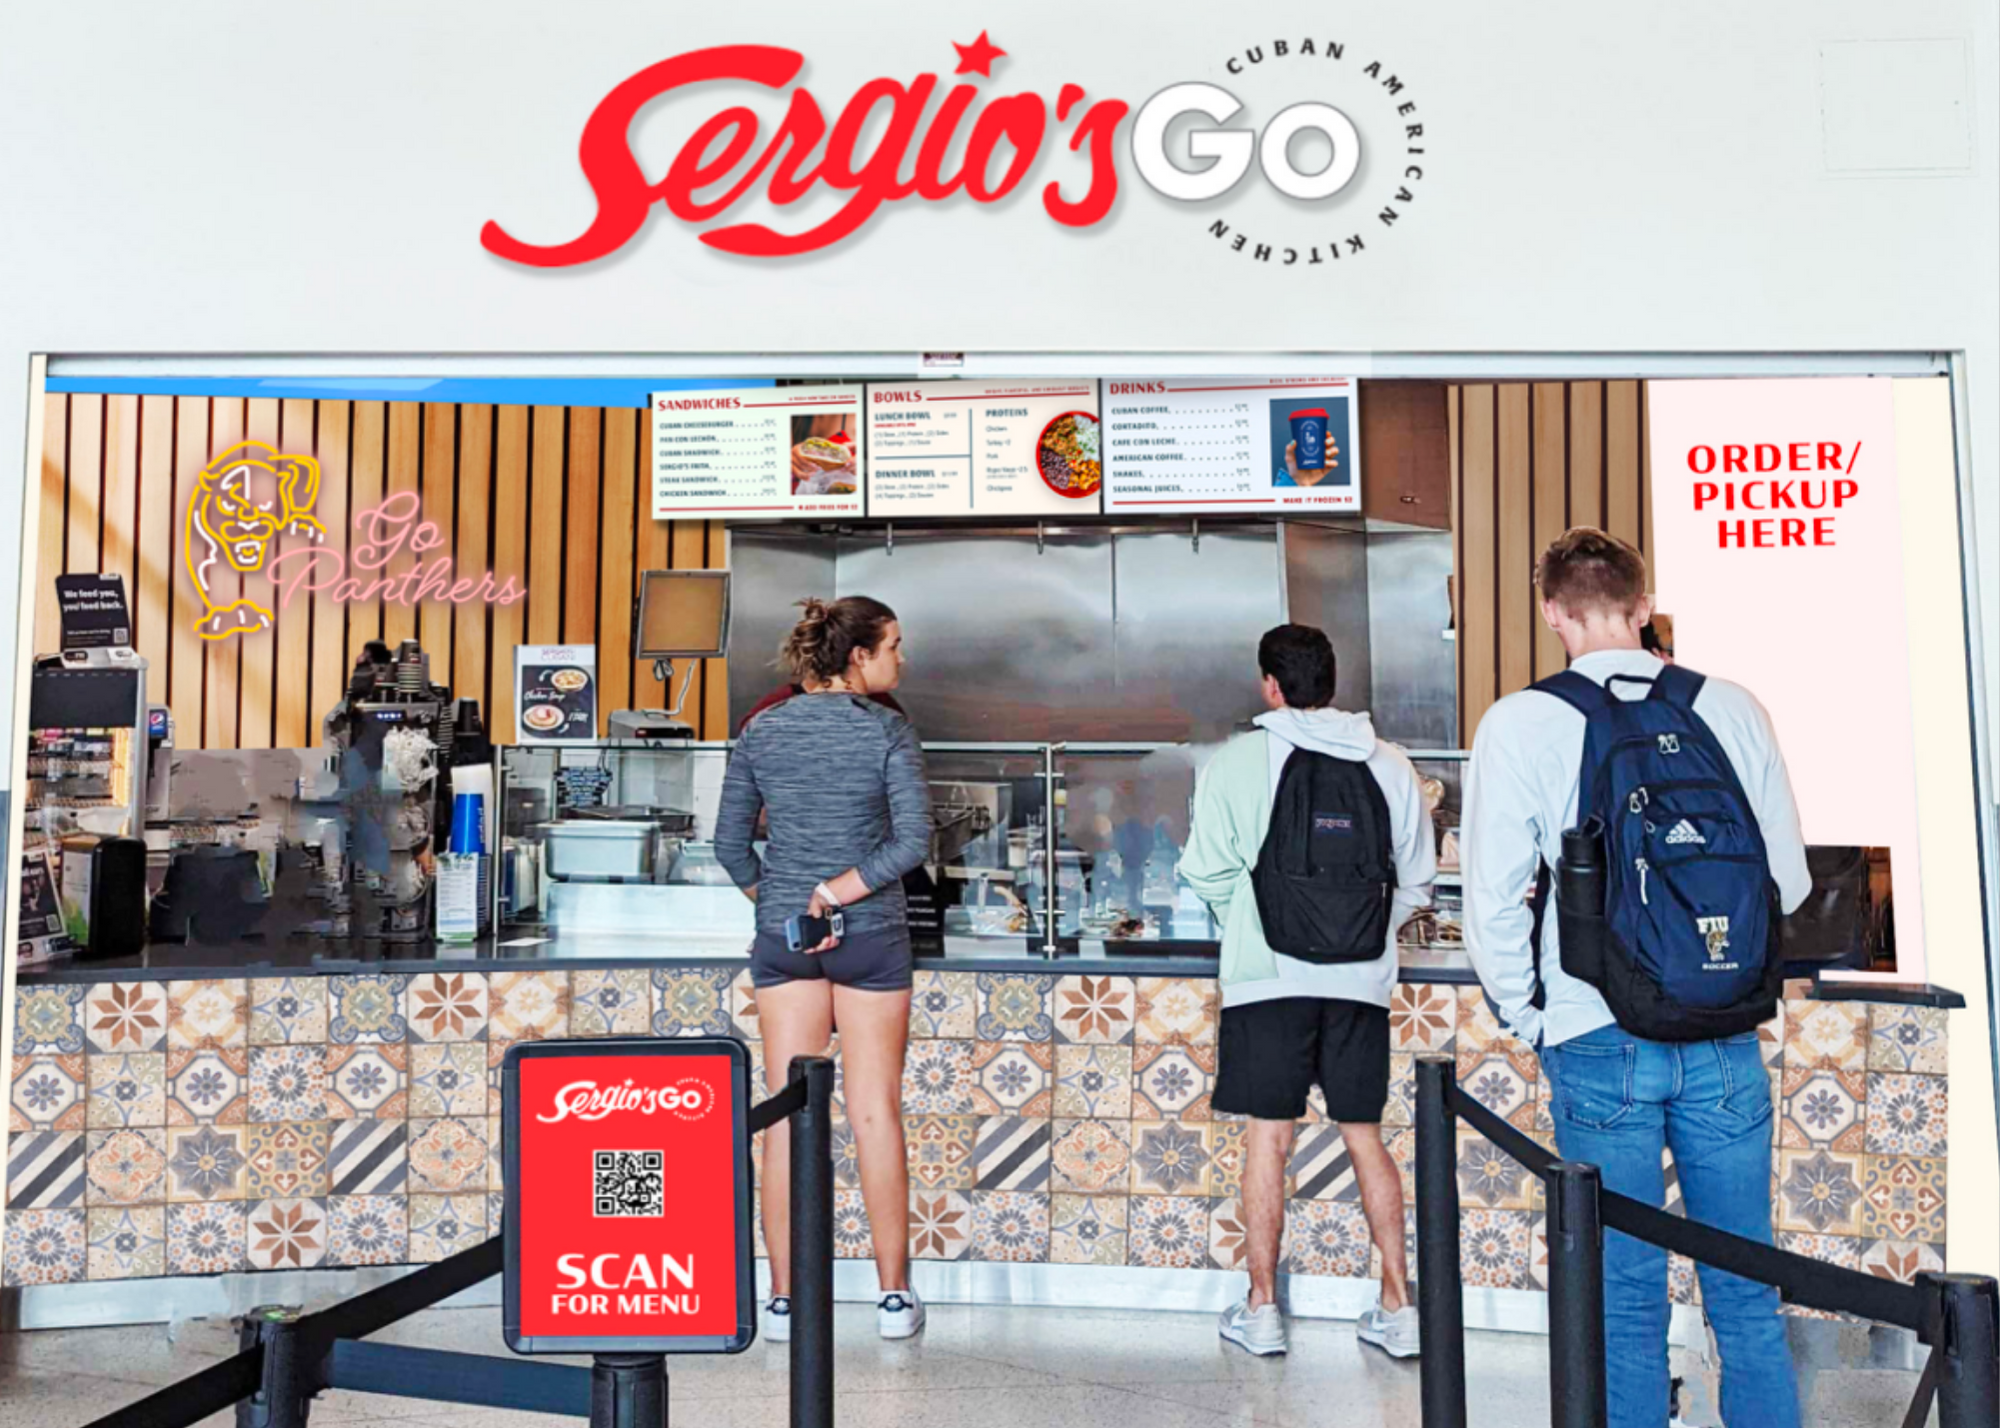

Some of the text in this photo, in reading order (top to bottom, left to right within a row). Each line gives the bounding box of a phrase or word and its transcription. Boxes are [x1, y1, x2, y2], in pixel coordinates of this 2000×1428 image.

[1225, 38, 1345, 75] CUBAN
[479, 29, 1129, 266] Sergio's
[1363, 60, 1425, 227] AMERICAN
[1208, 218, 1366, 266] KITCHEN
[1109, 381, 1166, 395] DRINKS
[873, 390, 922, 403] BOWLS
[658, 397, 741, 412] SANDWICHES
[1111, 406, 1168, 415] CUBAN COFFEE
[875, 411, 931, 421] LUNCH BOWL
[985, 408, 1028, 418] PROTEINS
[1112, 422, 1157, 430] CORTADITO
[1133, 438, 1150, 446] CON
[1152, 438, 1176, 446] LECHE
[1112, 452, 1184, 462] AMERICAN COFFEE
[1686, 440, 1862, 475] ORDER/
[875, 470, 908, 479] DINNER
[910, 470, 936, 478] BOWL
[1112, 470, 1143, 478] SHAKES
[1112, 484, 1181, 493] SEASONAL JUICES
[1693, 479, 1859, 511] PICKUP
[353, 491, 446, 570] Go
[1717, 517, 1837, 549] HERE
[267, 547, 527, 609] Panthers
[63, 588, 119, 600] We feed you,
[62, 600, 124, 613] you feed back.
[1665, 834, 1707, 844] adidas
[1696, 916, 1729, 934] FIU
[1702, 962, 1739, 970] SOCCER
[536, 1078, 659, 1124] Sergio's
[555, 1253, 695, 1289] SCAN
[551, 1293, 701, 1316] FOR MENU
